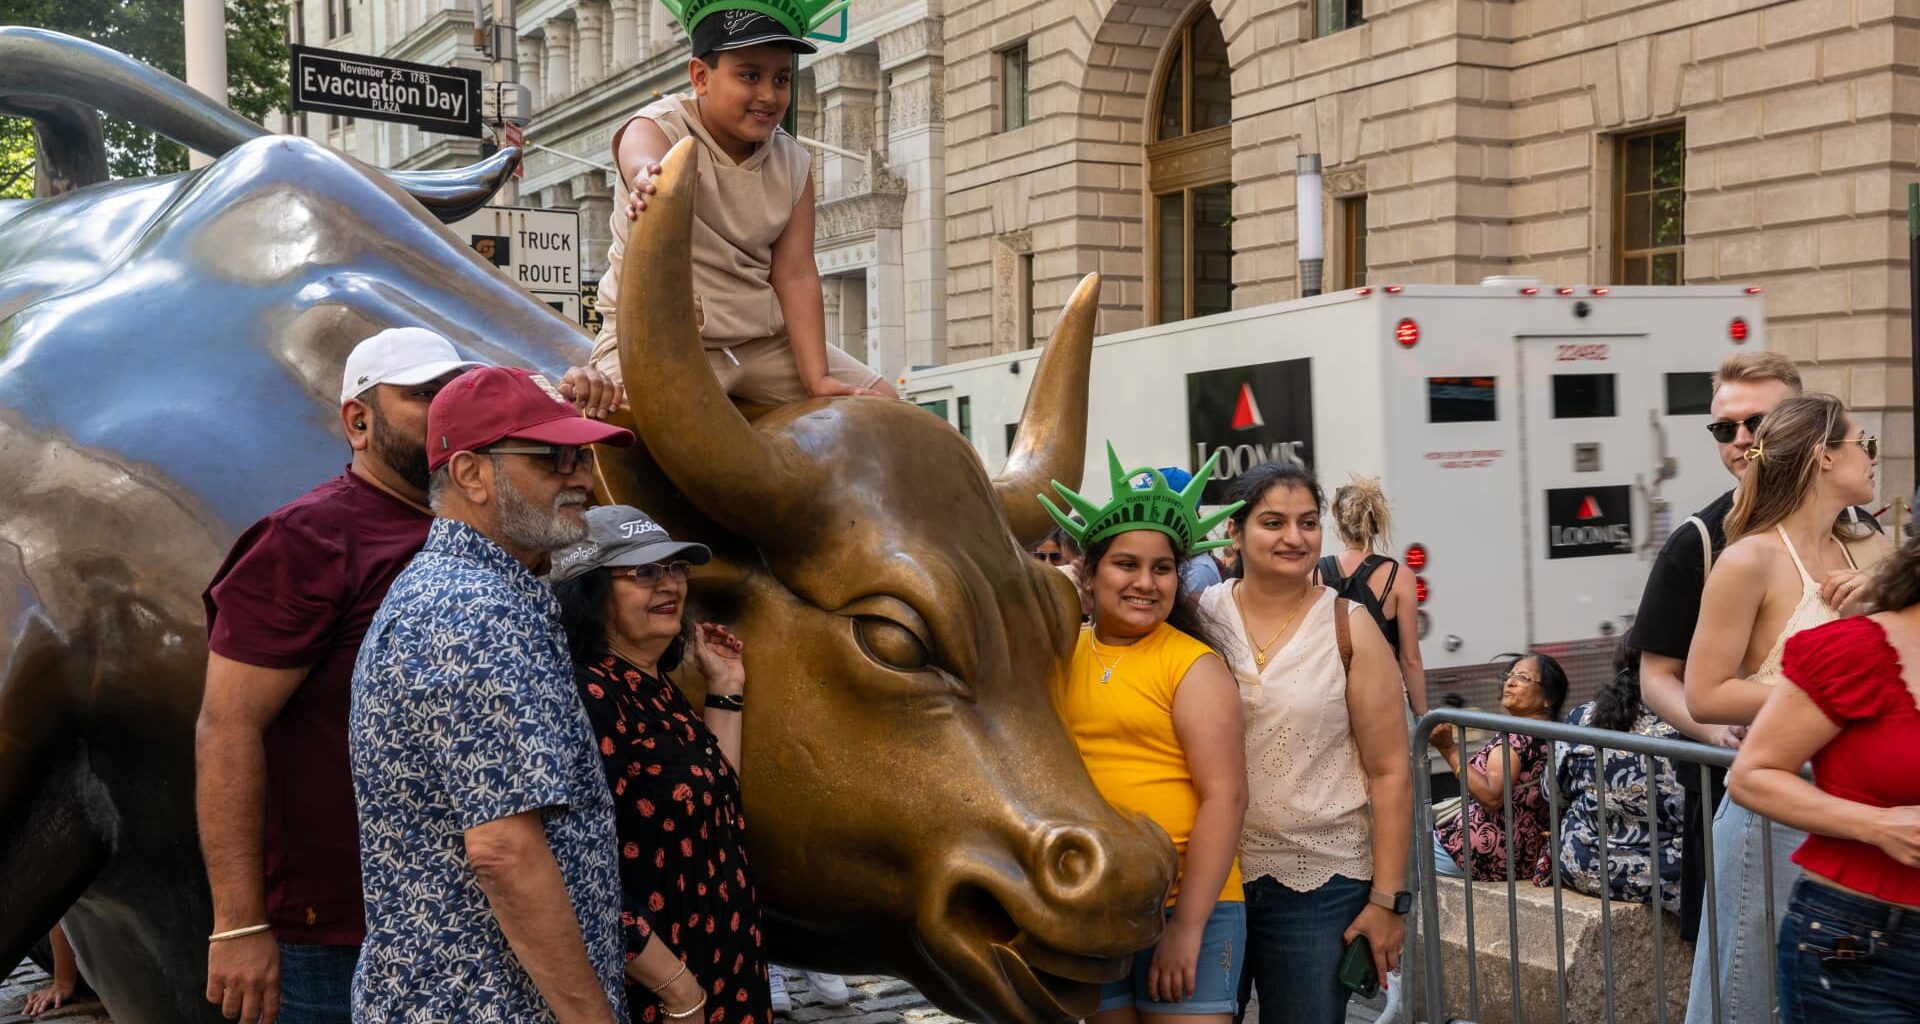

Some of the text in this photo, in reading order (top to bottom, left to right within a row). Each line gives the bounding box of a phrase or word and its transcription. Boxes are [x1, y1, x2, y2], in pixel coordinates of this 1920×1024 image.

[340, 62, 384, 78] November
[411, 72, 430, 85] 1783
[304, 67, 463, 116] Evacuation Day
[372, 100, 400, 112] PLAZA
[518, 231, 571, 251] TRUCK
[519, 264, 572, 284] ROUTE
[1551, 524, 1633, 547] LOOMIS
